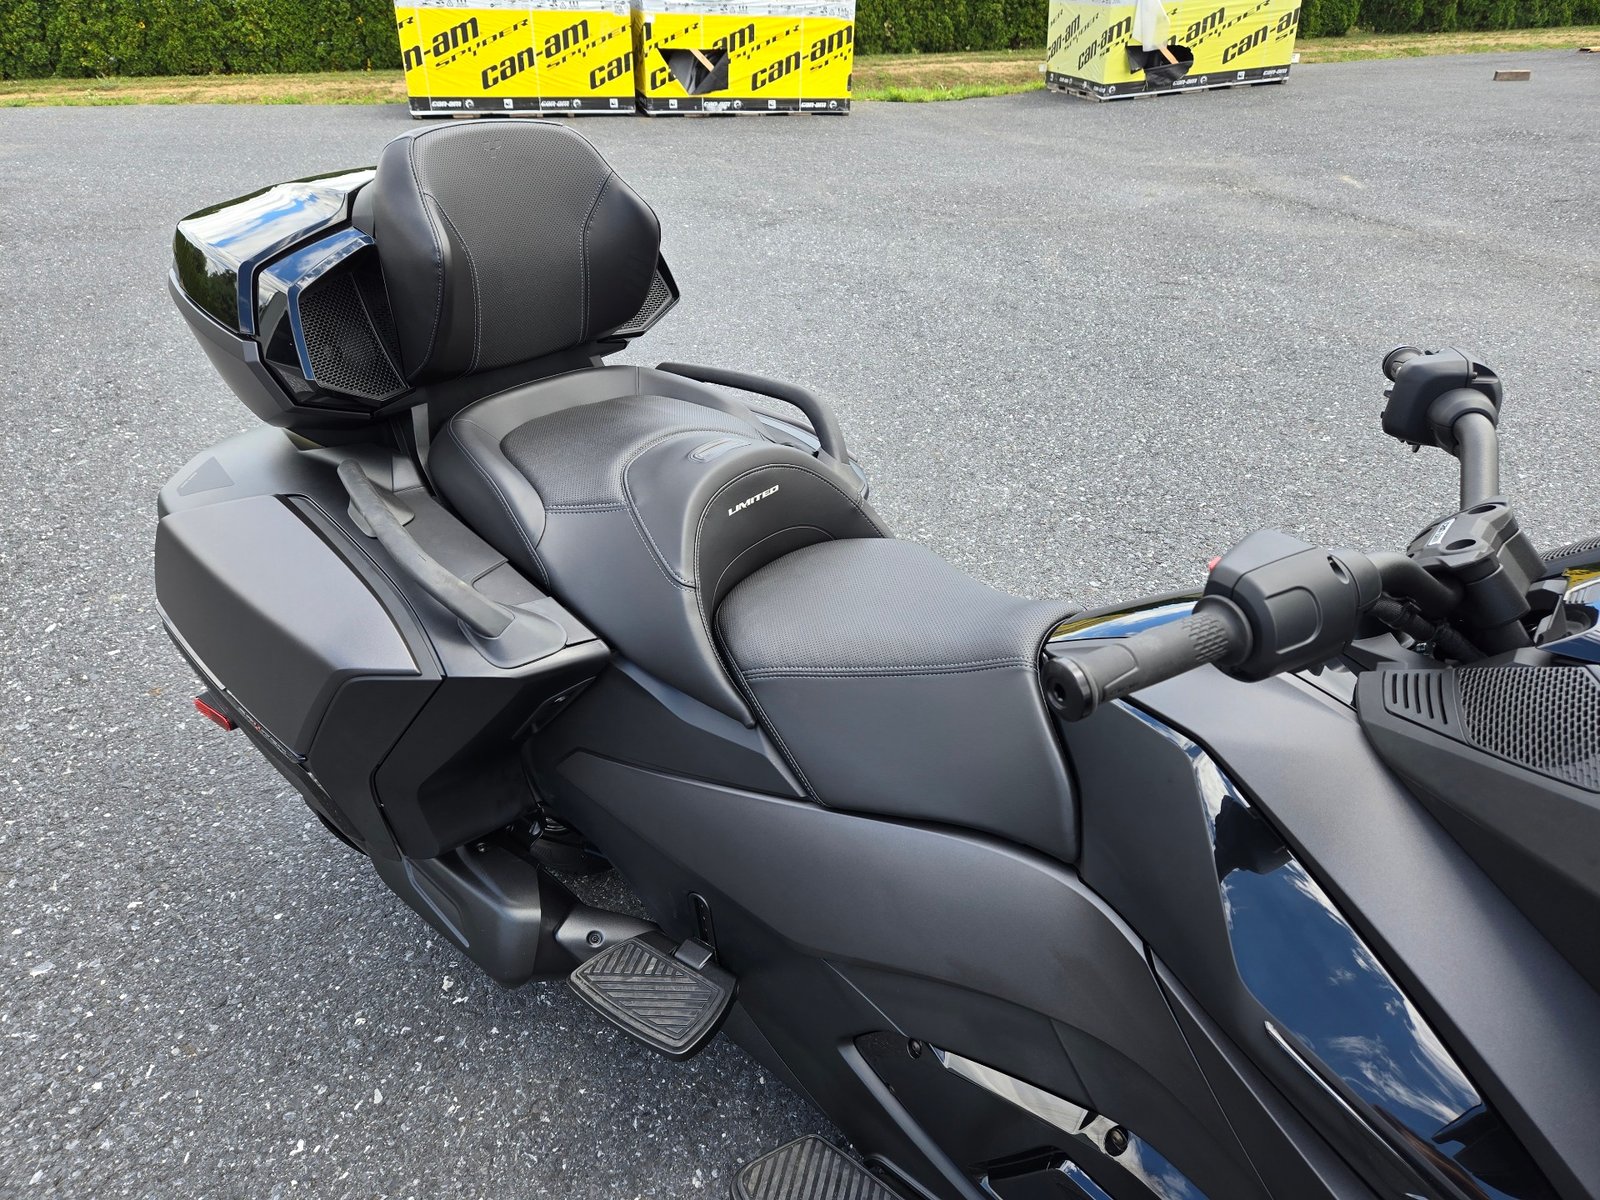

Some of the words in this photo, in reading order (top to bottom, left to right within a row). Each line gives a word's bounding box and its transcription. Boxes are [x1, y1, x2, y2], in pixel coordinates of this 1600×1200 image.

[481, 19, 588, 90] can-am
[751, 25, 852, 91] can-am
[1078, 16, 1131, 70] can-am
[728, 485, 779, 516] LIMITED
